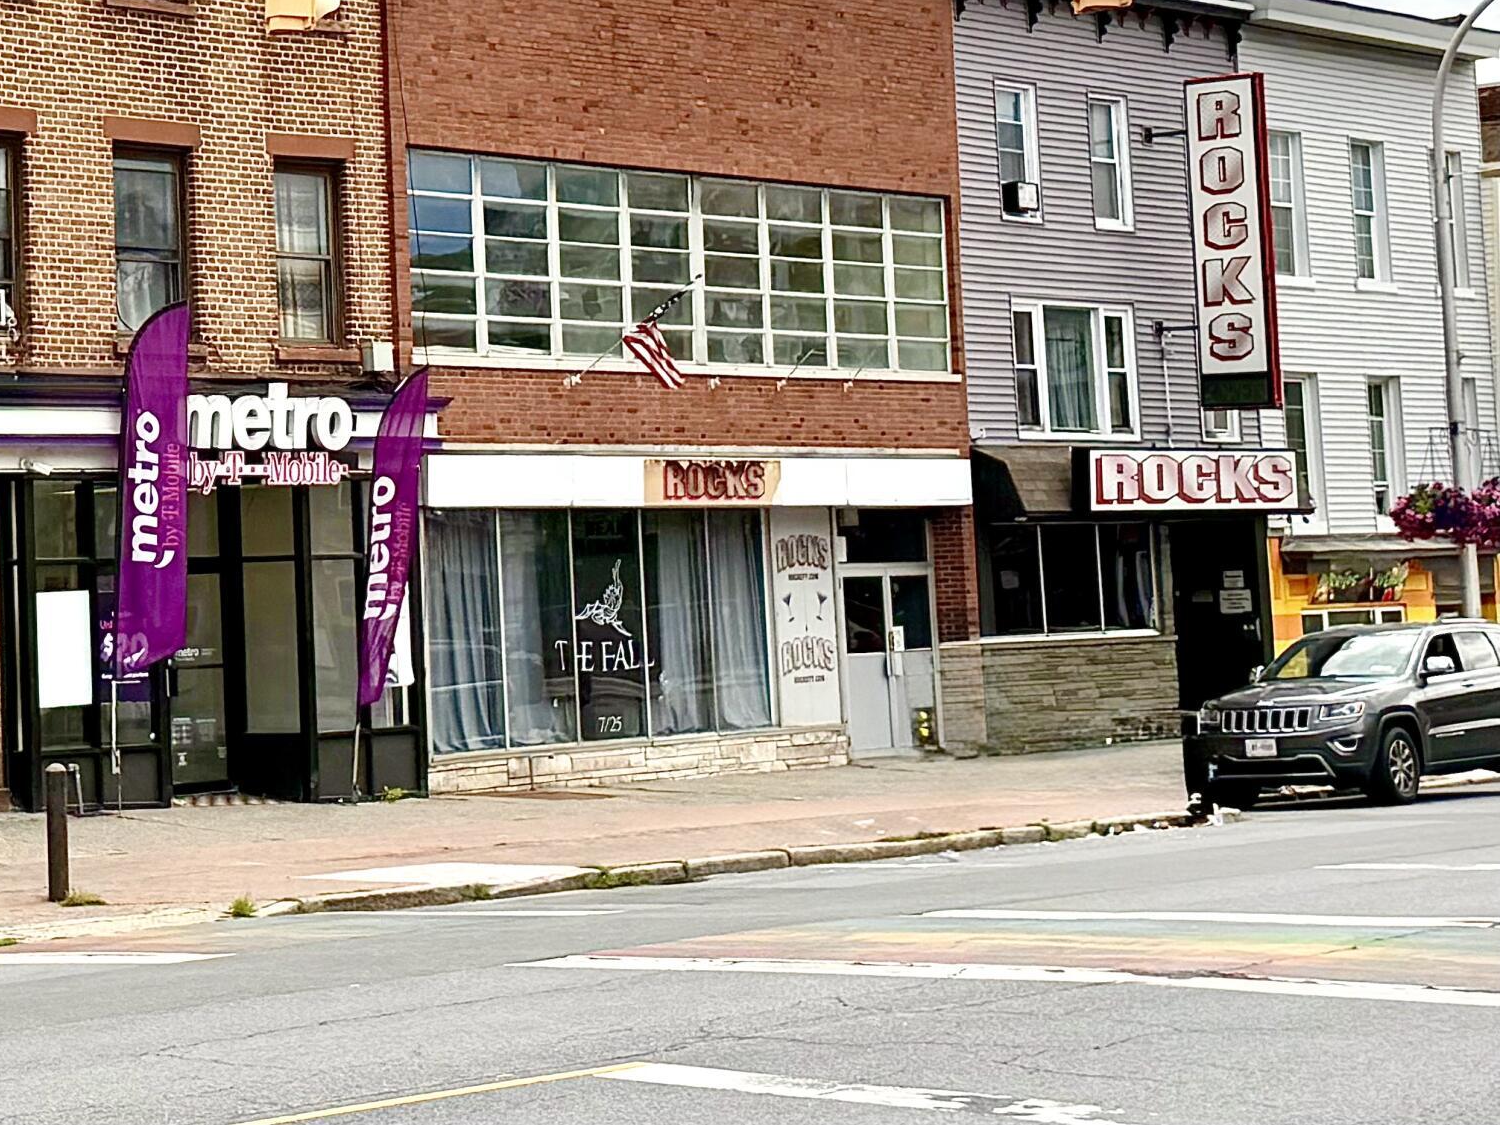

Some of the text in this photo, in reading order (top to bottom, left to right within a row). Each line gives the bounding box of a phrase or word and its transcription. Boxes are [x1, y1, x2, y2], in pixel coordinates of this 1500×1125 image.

[1196, 89, 1256, 362] ROCKS
[187, 382, 353, 451] metro
[127, 410, 160, 563] metro
[190, 452, 221, 495] by
[662, 461, 766, 501] ROCKS
[1095, 453, 1295, 505] ROCKS
[162, 525, 181, 548] by
[775, 534, 829, 573] ROCKS
[554, 640, 596, 672] THE
[781, 636, 835, 676] ROCKS
